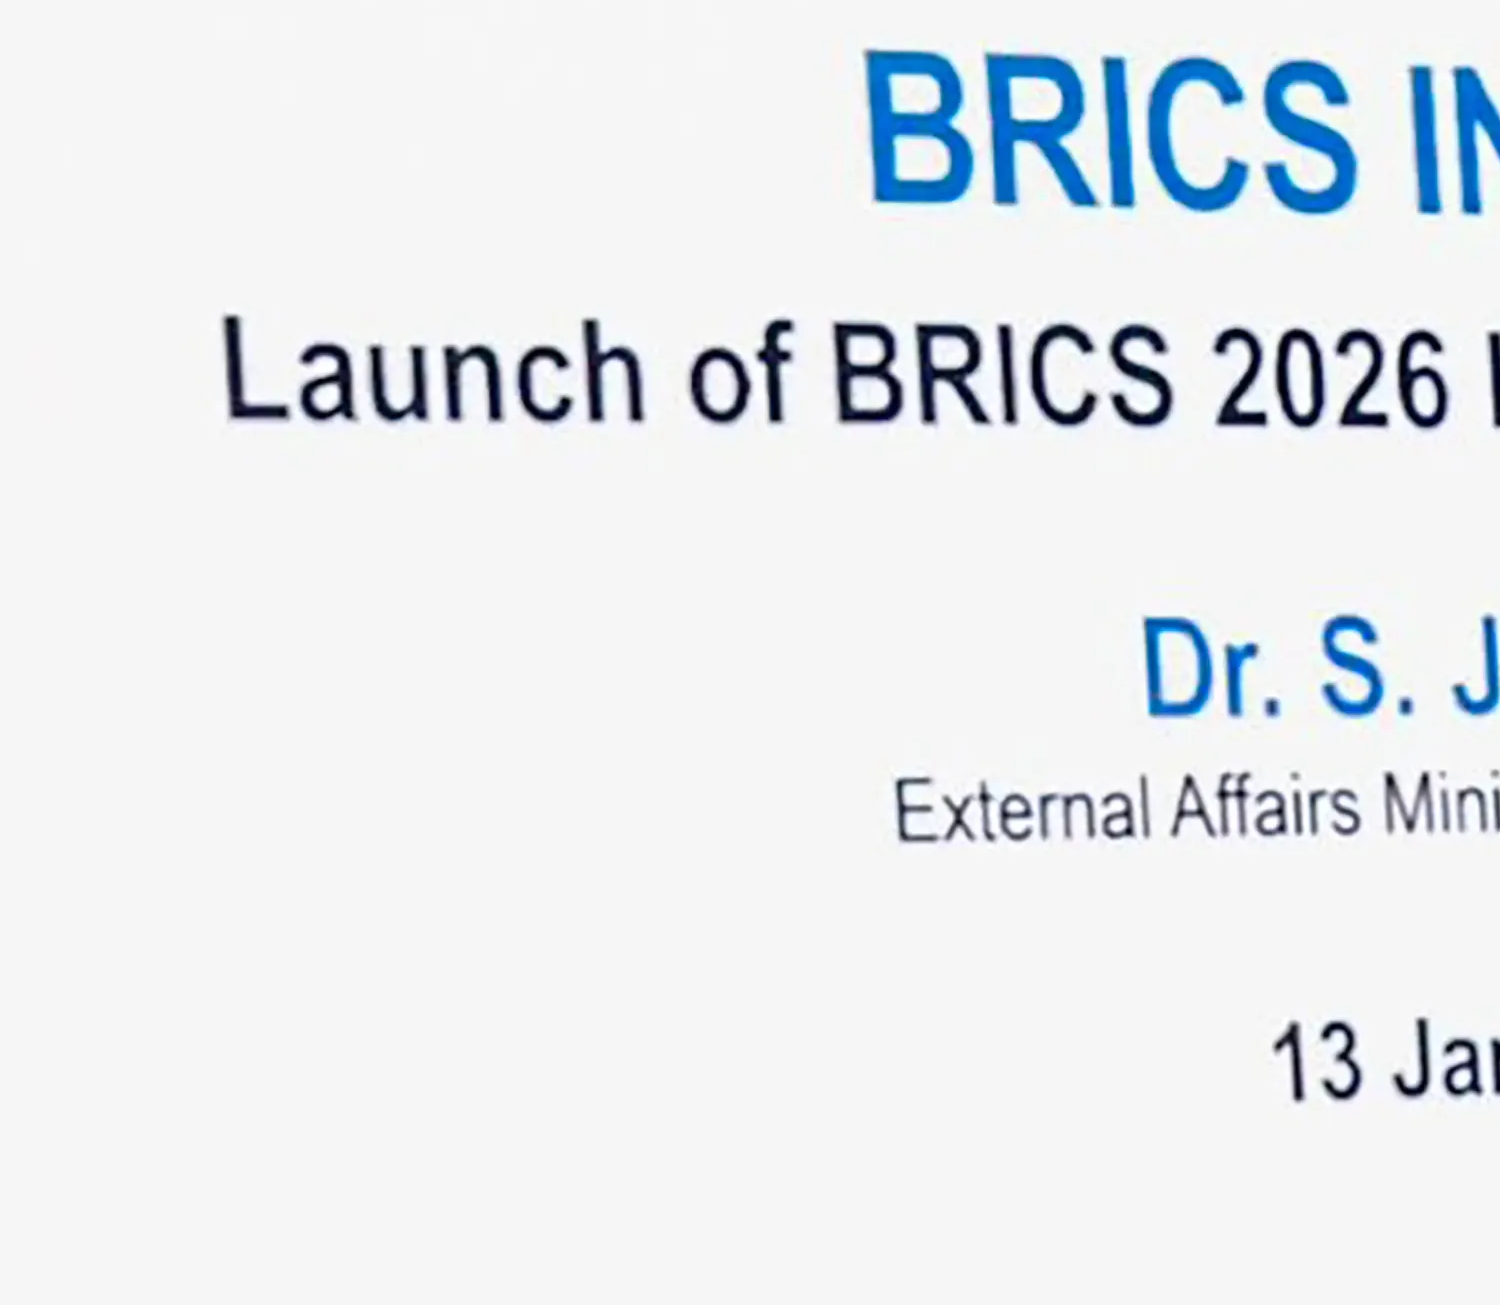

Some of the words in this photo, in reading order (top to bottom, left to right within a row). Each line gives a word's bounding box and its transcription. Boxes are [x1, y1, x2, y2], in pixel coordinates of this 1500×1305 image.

[863, 49, 1359, 216] BRICS
[222, 314, 645, 425] Launch
[688, 318, 795, 426] of
[832, 321, 1174, 428] BRICS
[1212, 326, 1450, 431] 2026
[1143, 616, 1281, 719] Dr.
[1320, 614, 1414, 719] S.
[895, 774, 1150, 843] External
[1170, 771, 1361, 838] Affairs
[1272, 1020, 1363, 1103] 13
